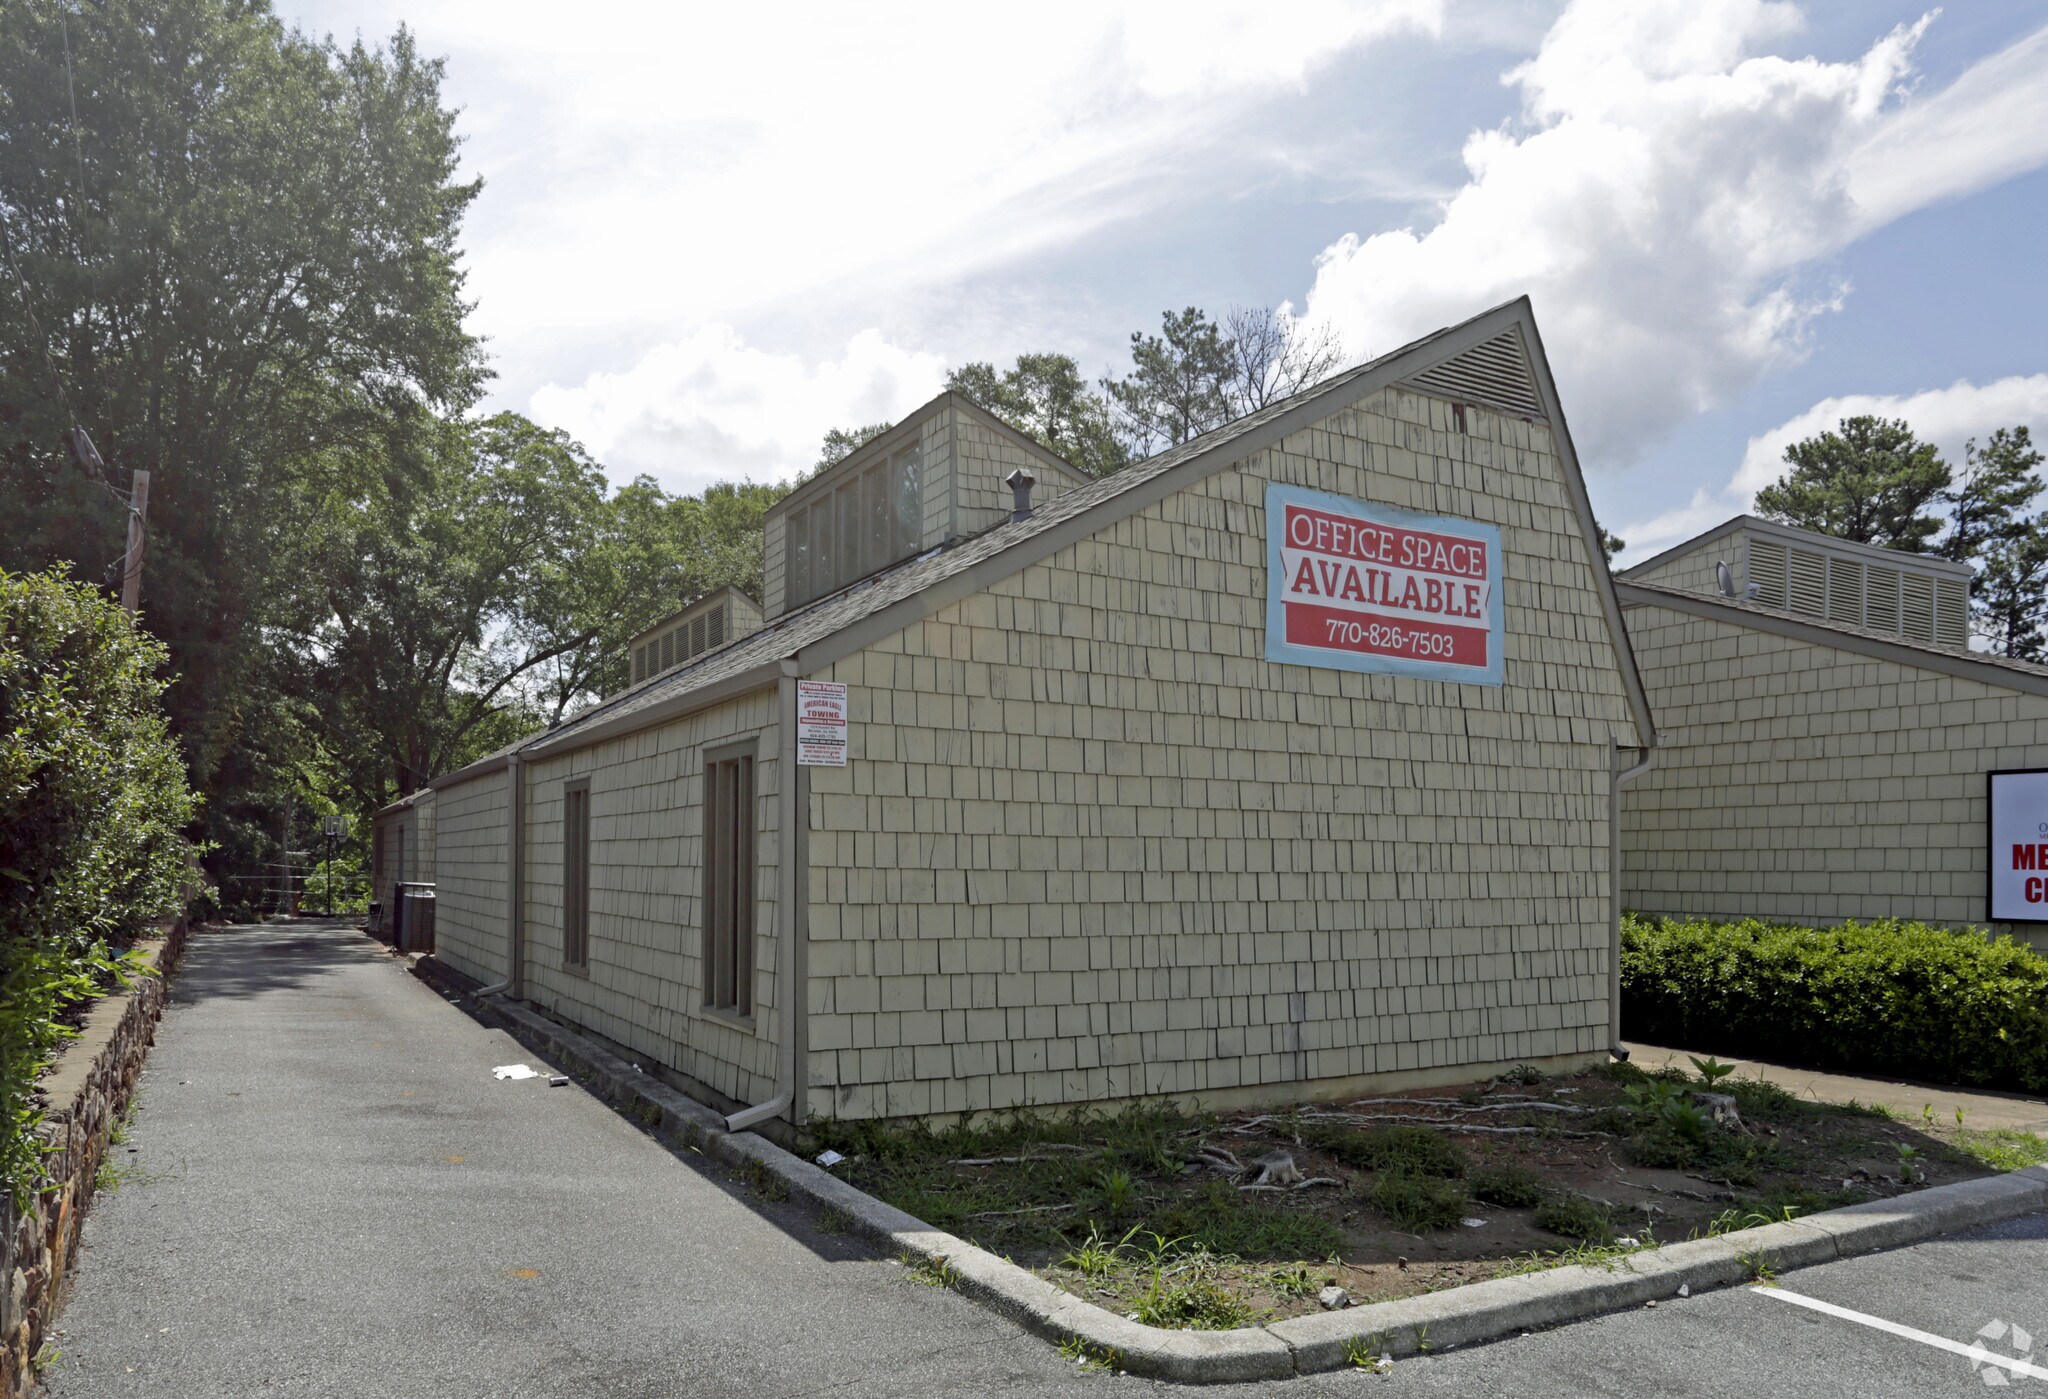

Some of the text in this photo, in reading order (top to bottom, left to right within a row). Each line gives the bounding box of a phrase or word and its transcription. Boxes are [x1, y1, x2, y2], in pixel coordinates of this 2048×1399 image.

[1290, 514, 1483, 577] OFFICE SPACE
[1290, 556, 1482, 620] AVAILABLE
[1326, 618, 1454, 658] 770-826-7503
[804, 699, 842, 712] AMERICAN EAGLE
[807, 710, 840, 719] TOWING
